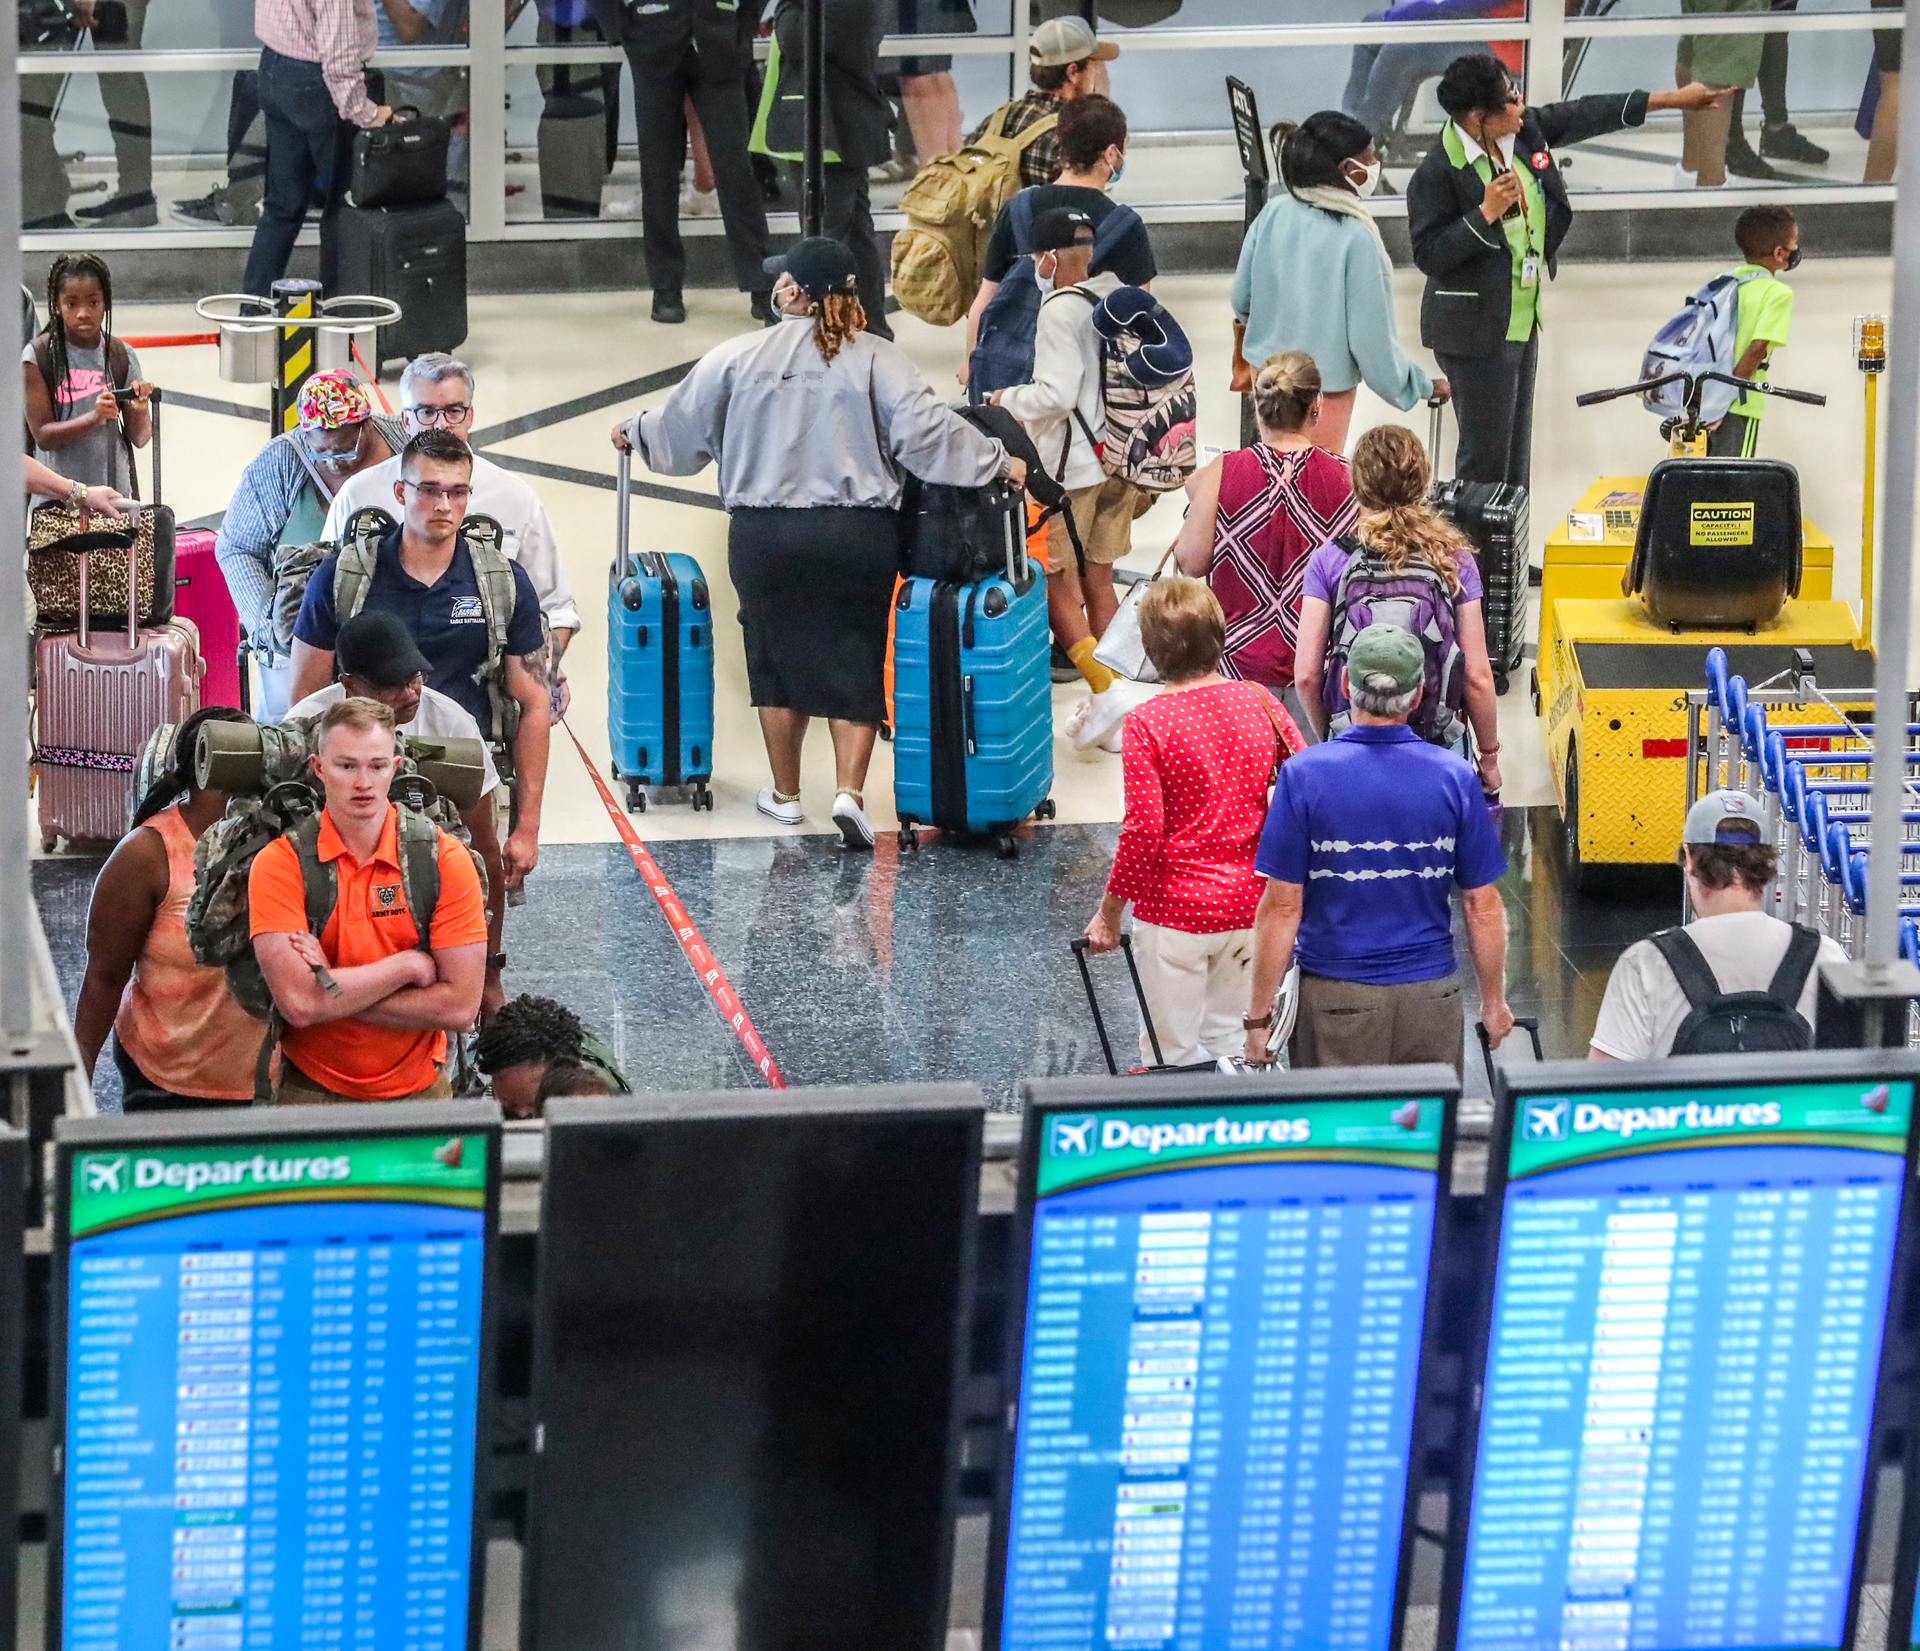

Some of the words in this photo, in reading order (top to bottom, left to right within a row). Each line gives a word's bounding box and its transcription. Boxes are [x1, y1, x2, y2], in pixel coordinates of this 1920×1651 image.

[1232, 87, 1252, 117] ATL
[69, 368, 104, 389] NIKE
[1694, 510, 1750, 519] CAUTION
[629, 843, 646, 856] ATL
[652, 885, 670, 898] ATL
[677, 927, 695, 942] ATL
[704, 968, 719, 987] ATL
[731, 1011, 746, 1031] ATL
[759, 1056, 771, 1077] ATL
[1574, 1100, 1783, 1137] Departures
[1101, 1116, 1312, 1155] Departures
[133, 1154, 353, 1192] Departures
